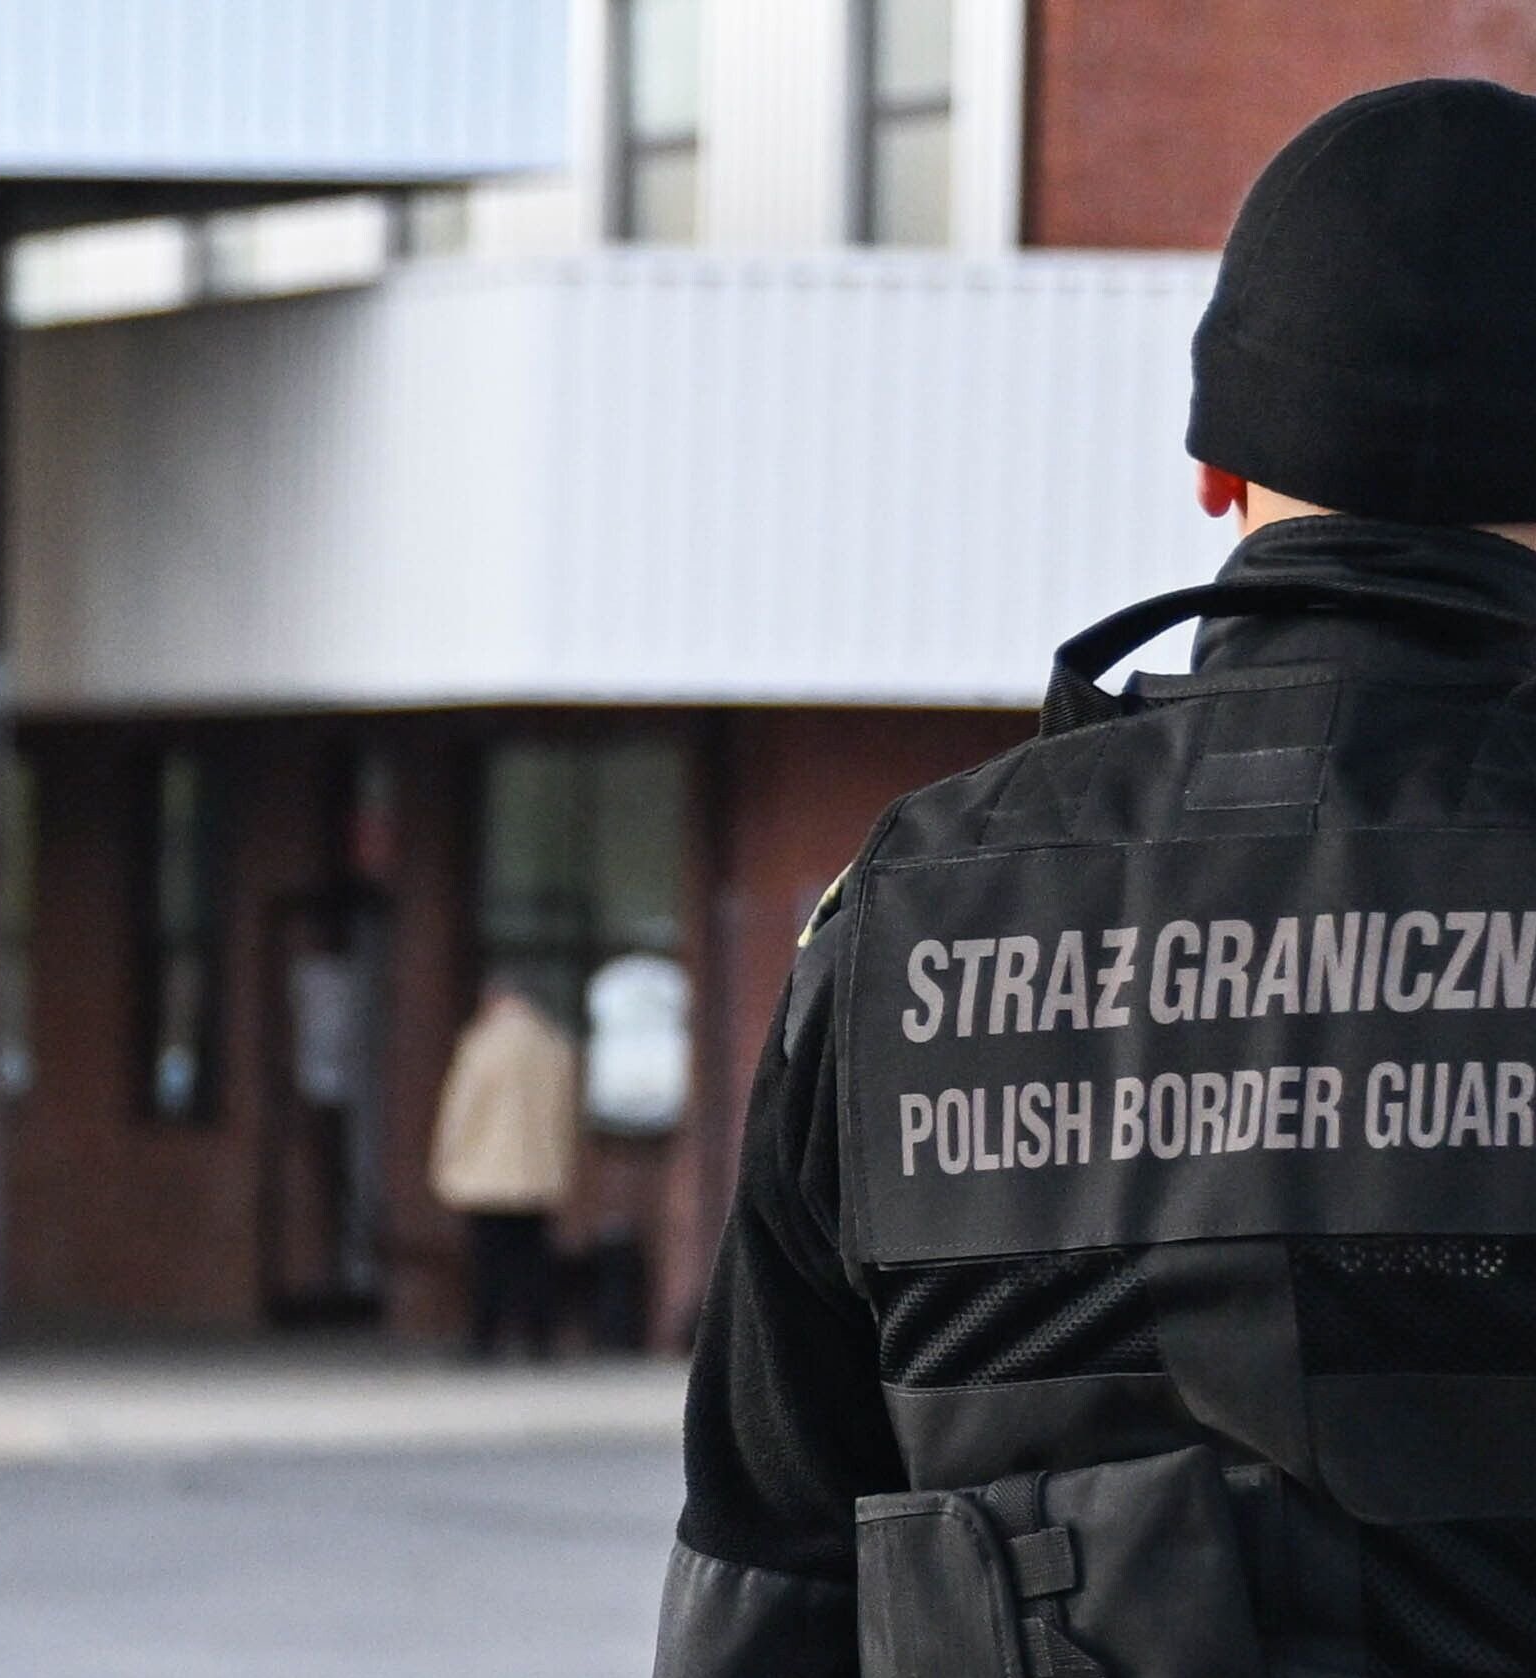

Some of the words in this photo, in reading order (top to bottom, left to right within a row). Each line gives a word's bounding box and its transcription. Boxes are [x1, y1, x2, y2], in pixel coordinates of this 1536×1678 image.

[901, 927, 1138, 1043] STRAŻ
[900, 1081, 1092, 1177] POLISH
[1111, 1065, 1341, 1161] BORDER
